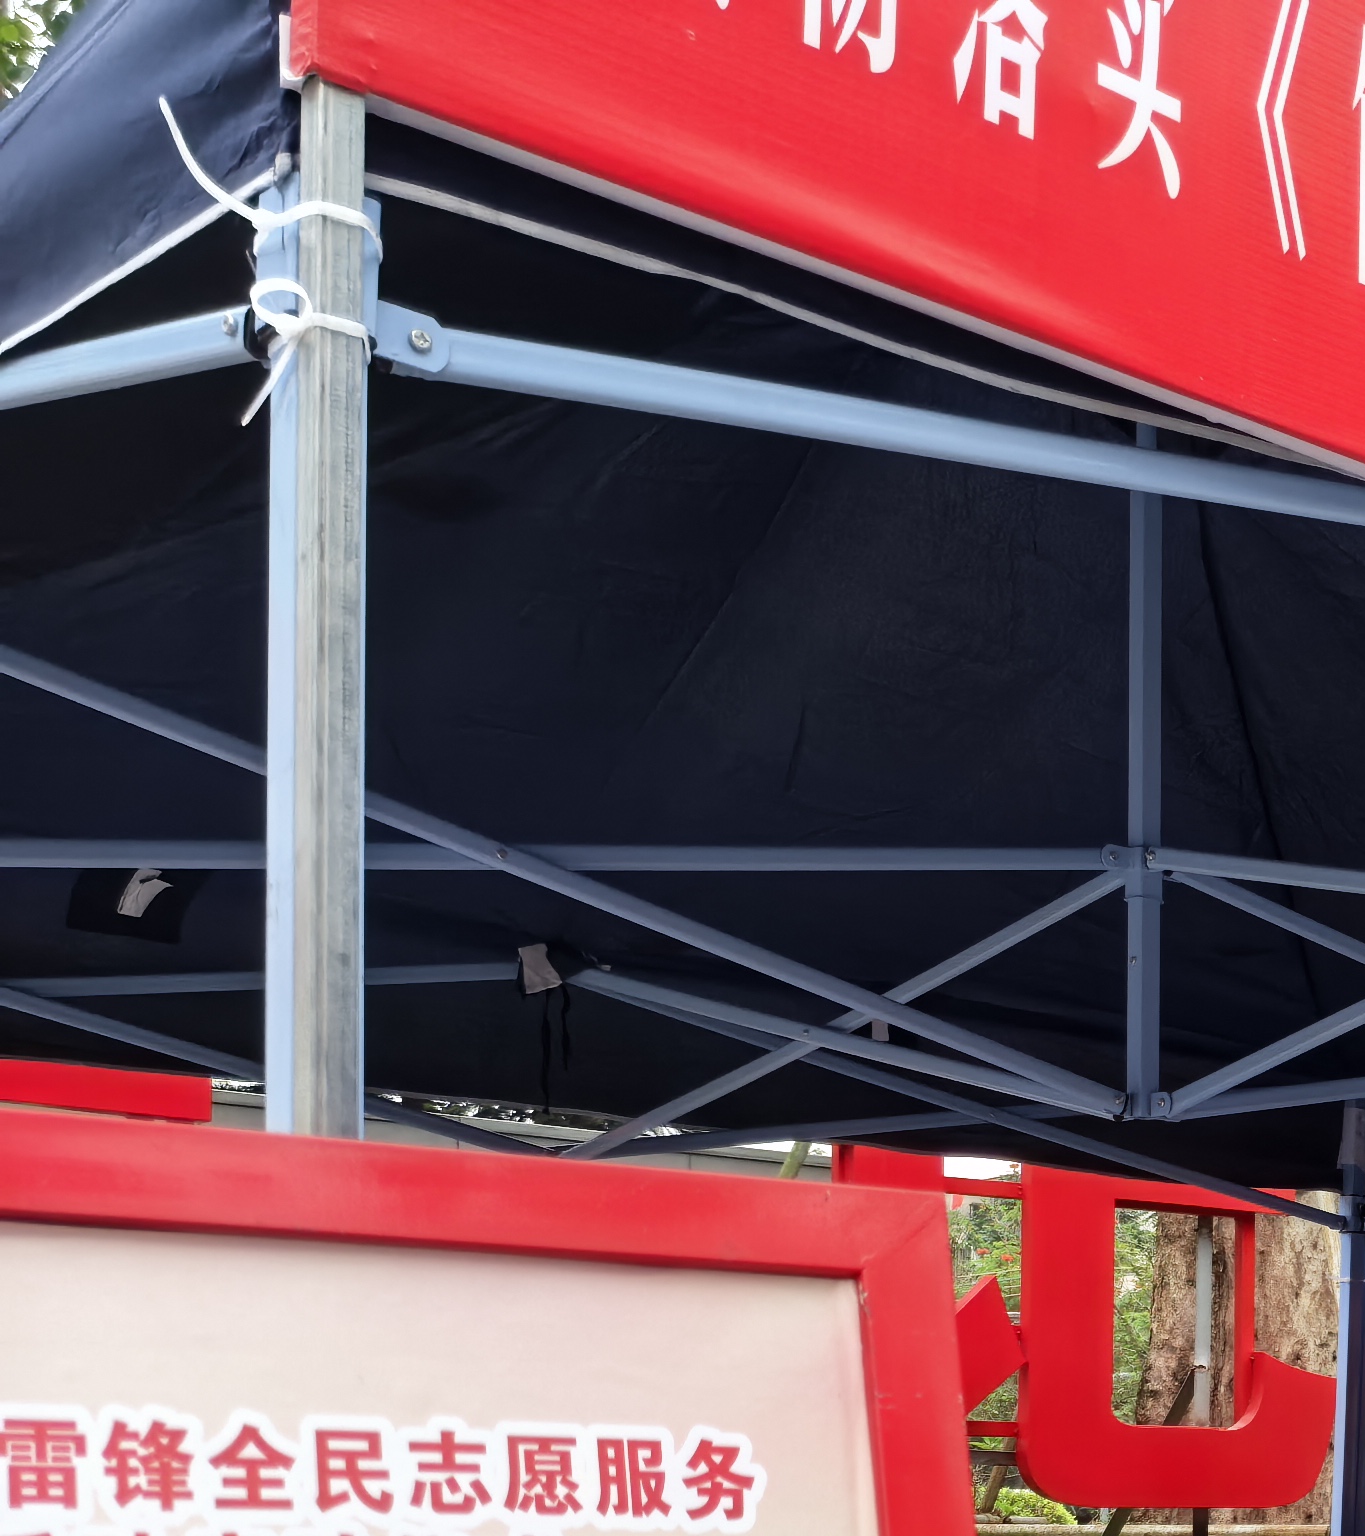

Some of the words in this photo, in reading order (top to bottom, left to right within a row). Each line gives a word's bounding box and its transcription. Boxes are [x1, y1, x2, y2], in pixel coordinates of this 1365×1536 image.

[0, 1418, 757, 1521] 雷锋全民志愿服务
